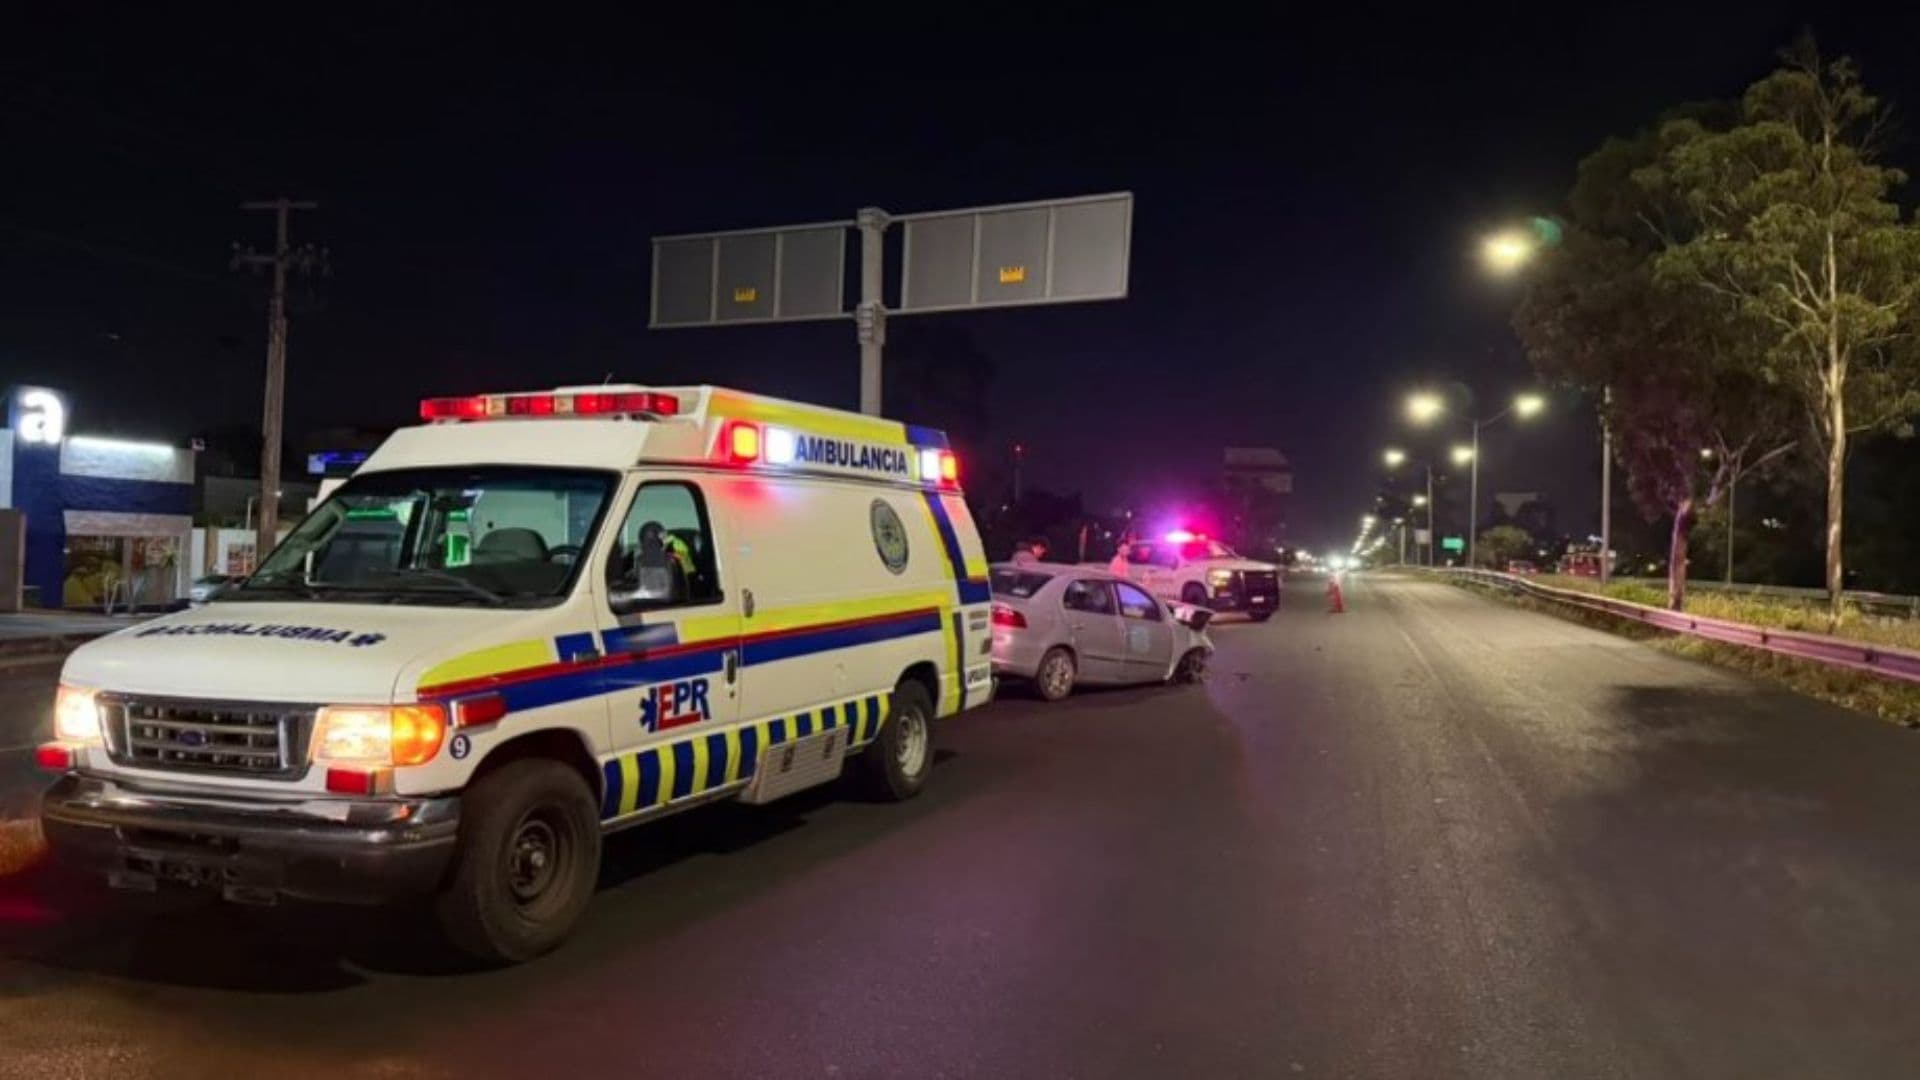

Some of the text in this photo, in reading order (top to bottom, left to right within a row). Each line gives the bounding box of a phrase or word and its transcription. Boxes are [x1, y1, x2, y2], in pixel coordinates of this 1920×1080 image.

[20, 388, 63, 445] a
[795, 435, 908, 474] AMBULANCIA
[657, 678, 711, 731] EPR
[454, 736, 466, 758] 9
